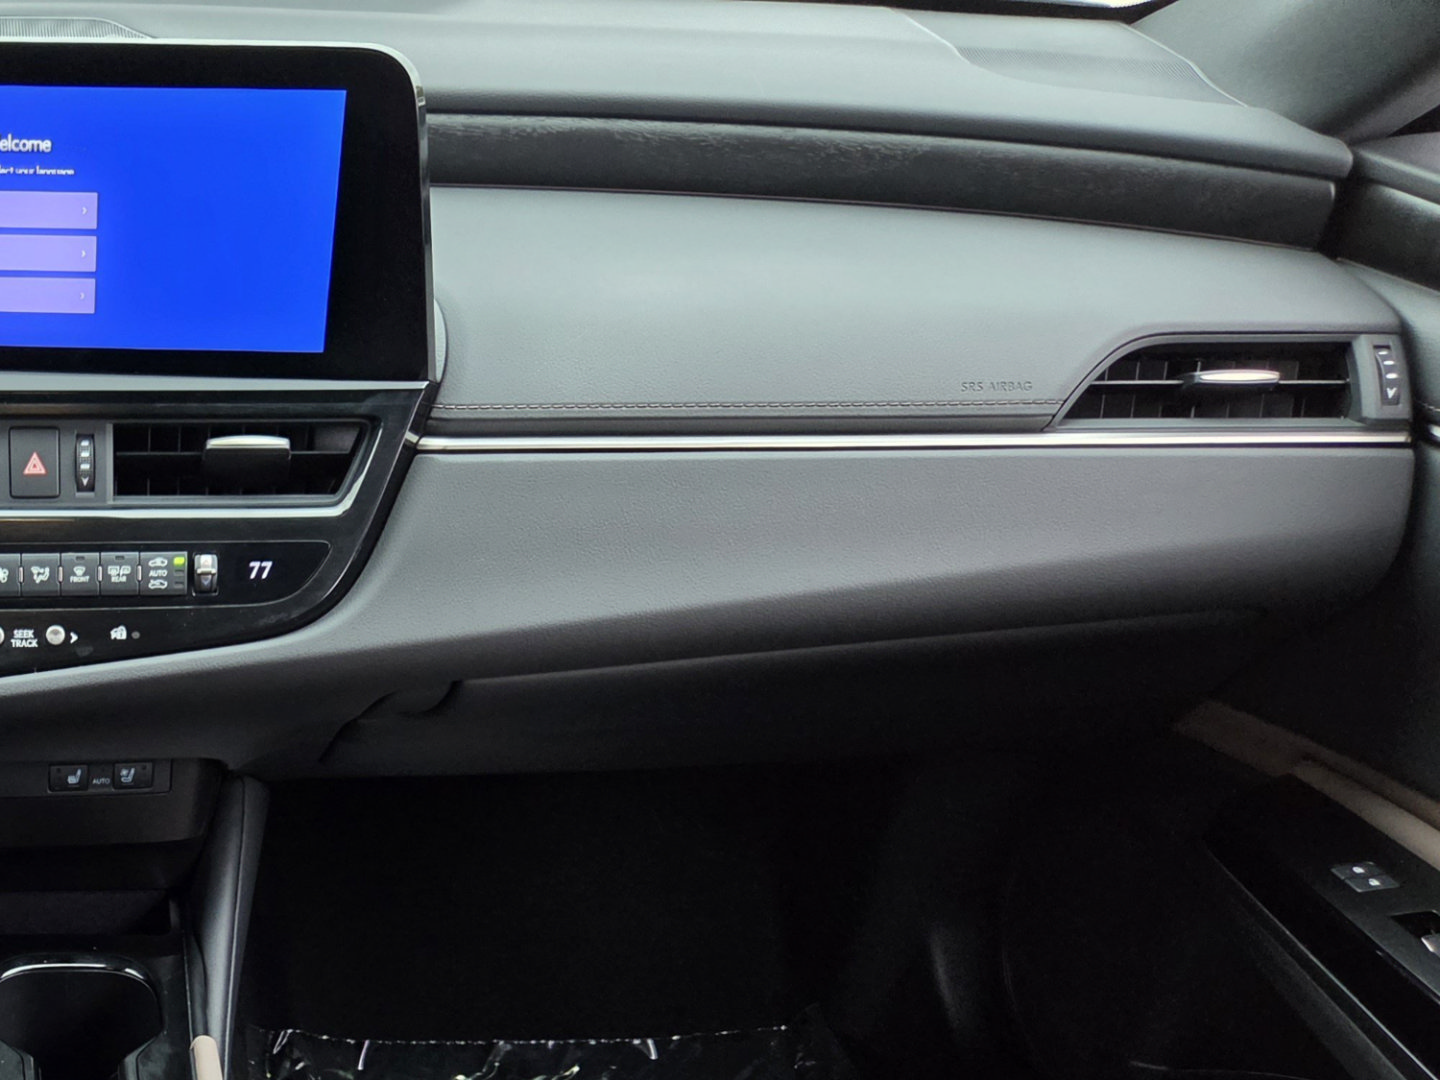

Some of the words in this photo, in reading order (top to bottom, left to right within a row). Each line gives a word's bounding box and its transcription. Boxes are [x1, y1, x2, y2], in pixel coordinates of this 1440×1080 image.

[960, 381, 984, 392] SRS
[990, 381, 1033, 392] AIRBAG
[148, 569, 168, 577] AUTO
[248, 561, 273, 580] 77
[69, 575, 90, 583] FRONT
[13, 629, 34, 639] SEEK
[10, 639, 39, 648] TRACK
[92, 777, 111, 785] AUTO
